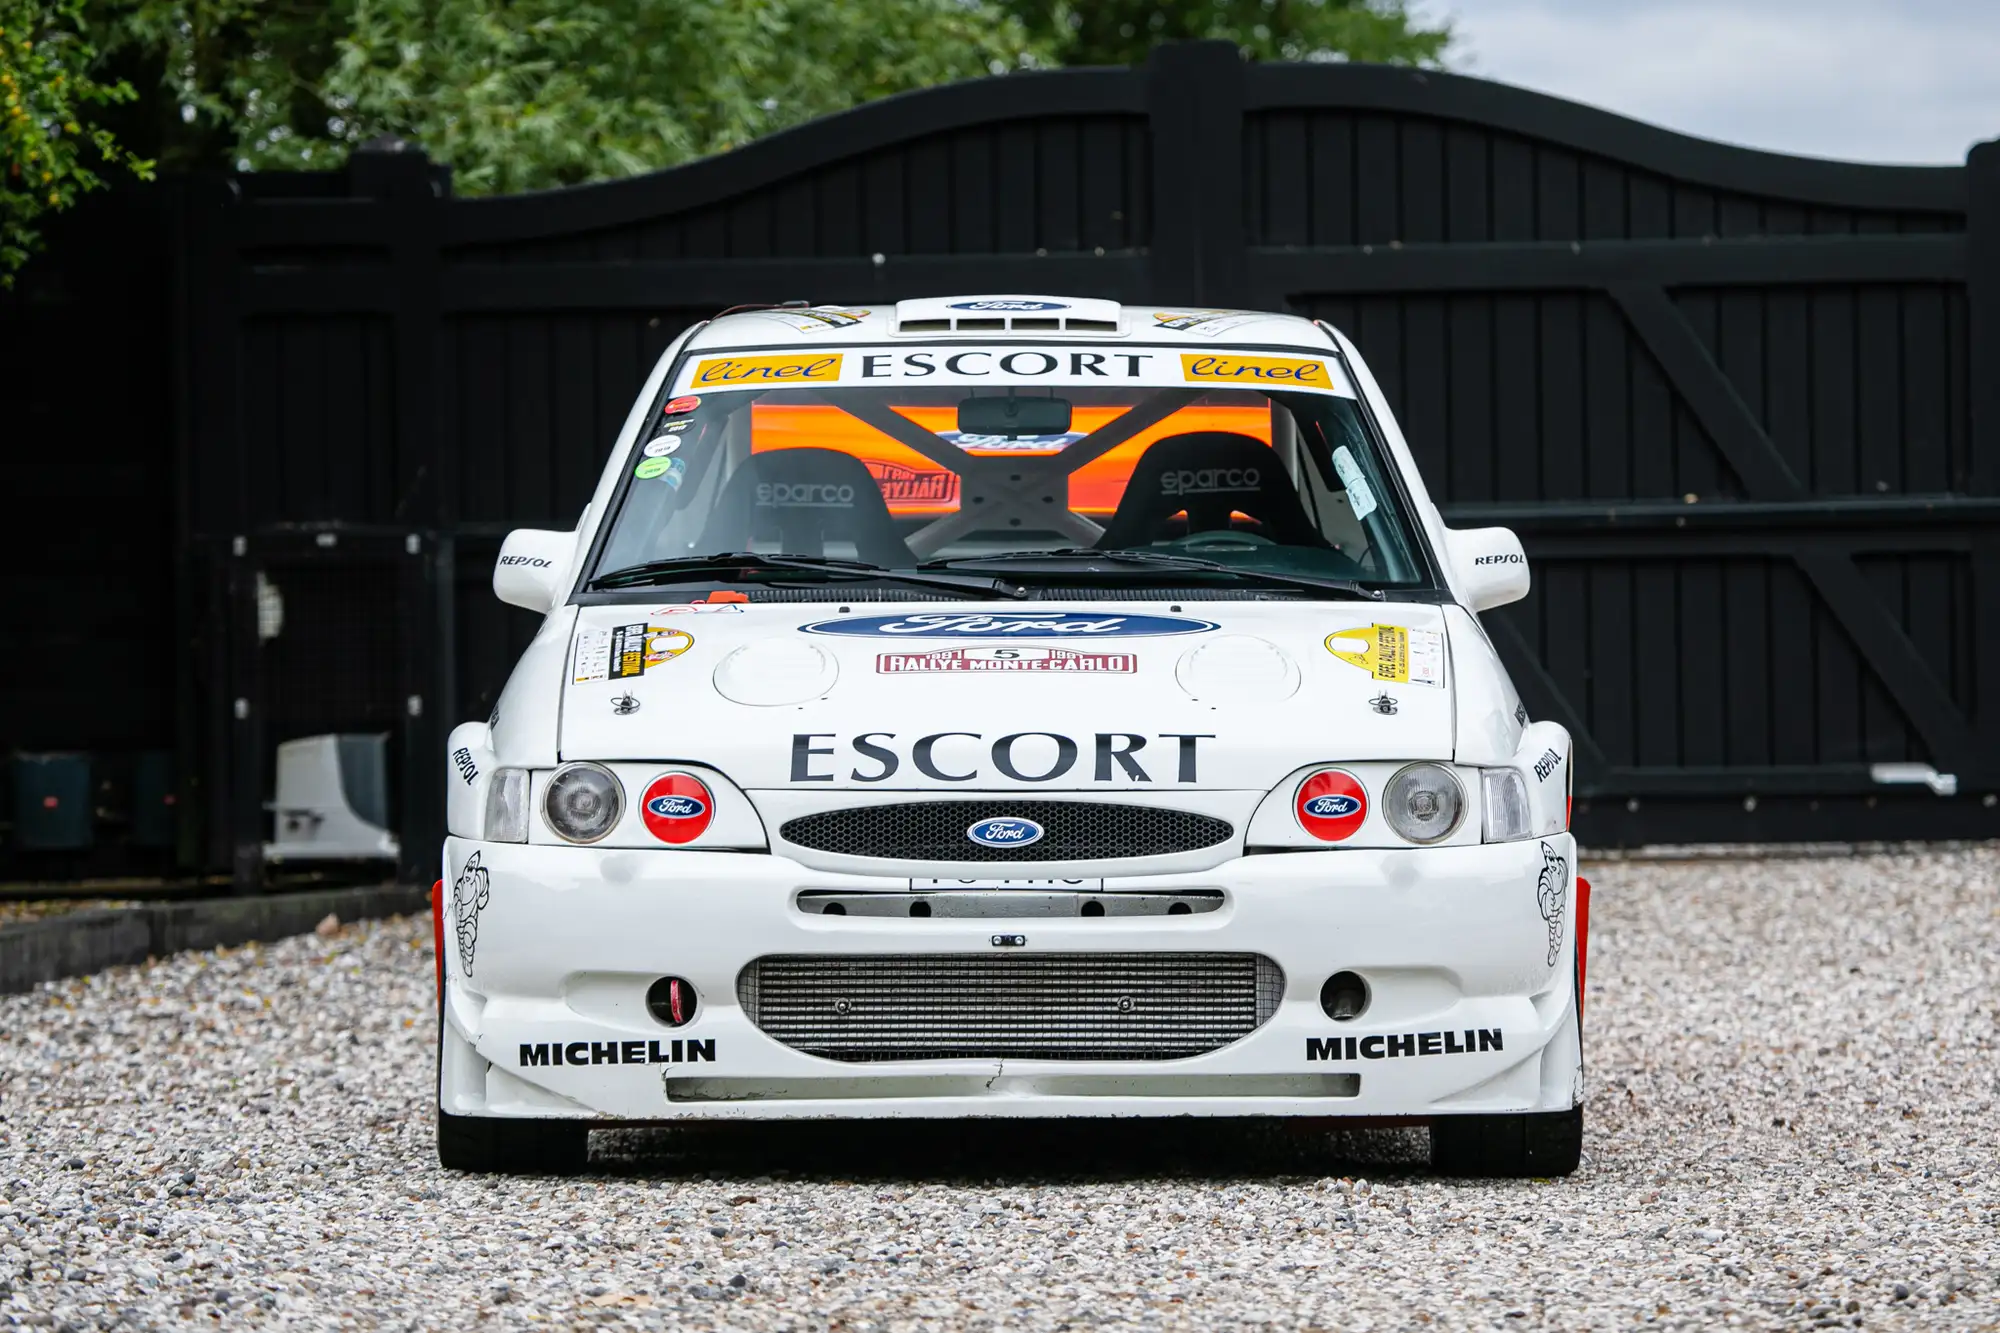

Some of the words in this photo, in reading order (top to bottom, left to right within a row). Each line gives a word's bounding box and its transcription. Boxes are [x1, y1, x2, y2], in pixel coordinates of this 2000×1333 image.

[969, 300, 1043, 311] Ford
[700, 357, 836, 383] linel
[861, 352, 1154, 378] ESCORT
[1191, 357, 1321, 382] linel
[957, 434, 1069, 450] Ford
[1160, 468, 1261, 495] sparco
[755, 484, 855, 508] sparco
[500, 555, 552, 568] REPSOL
[1475, 554, 1524, 566] REPSOL
[878, 613, 1121, 635] Ford
[890, 656, 962, 671] RALLYE
[969, 656, 1124, 671] MONTE-CARLO
[992, 648, 1021, 660] 5
[452, 747, 480, 786] REPSOL
[789, 732, 1217, 783] ESCORT
[1533, 748, 1563, 783] REPSOL
[658, 796, 693, 815] Ford
[1314, 797, 1349, 814] Ford
[984, 821, 1026, 842] Ford
[519, 1038, 716, 1067] MICHELIN
[1306, 1028, 1504, 1061] MICHELIN
